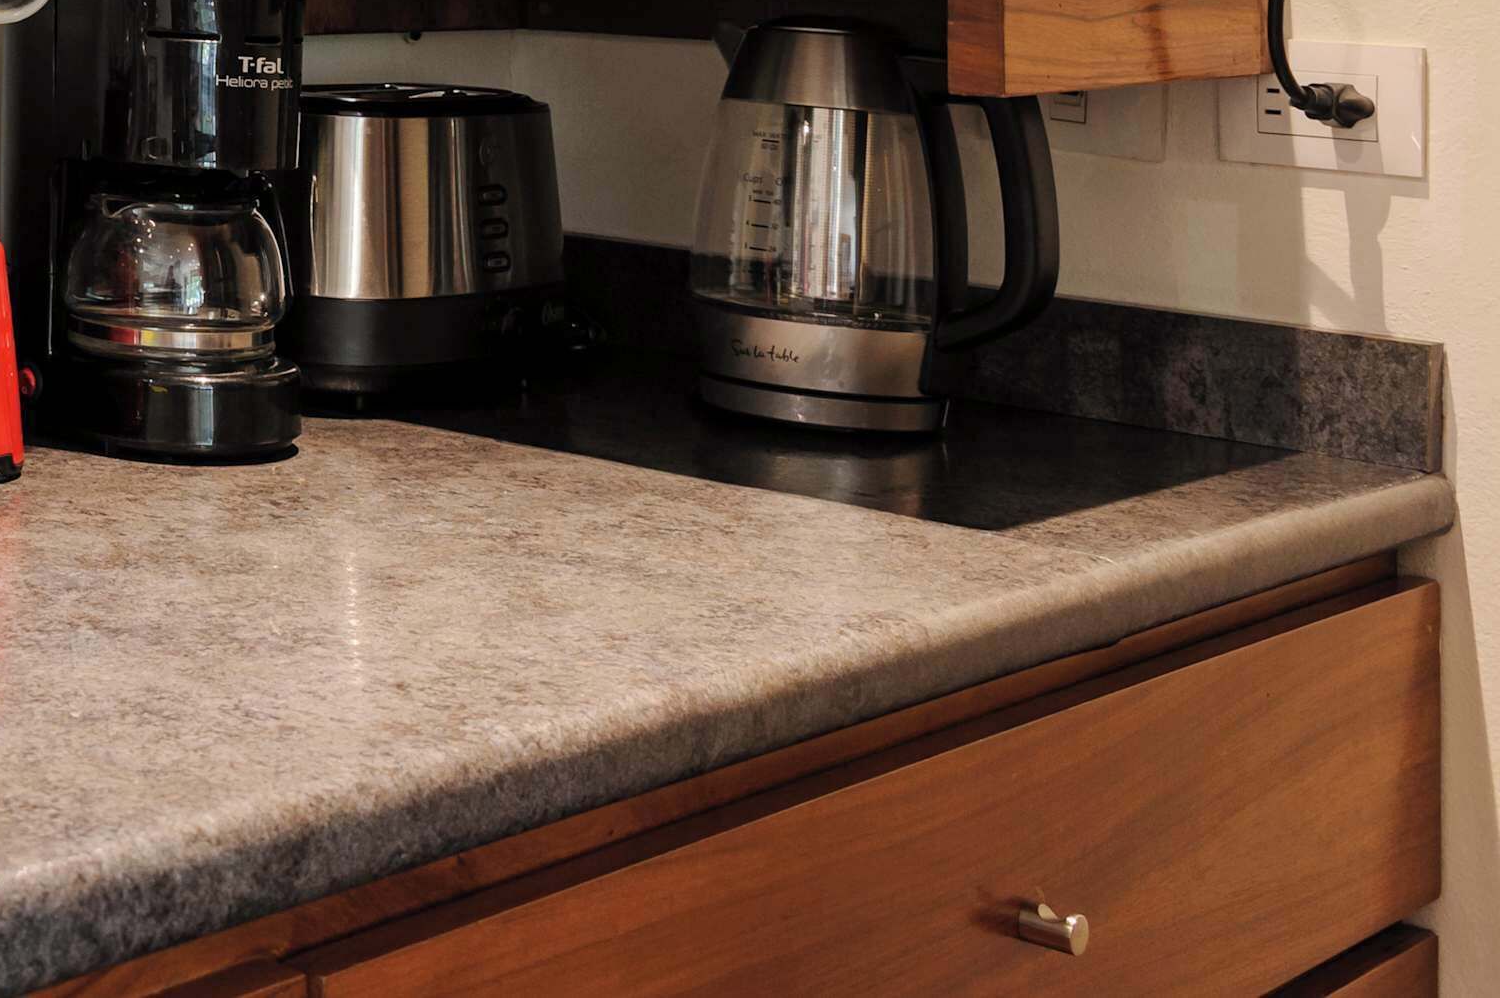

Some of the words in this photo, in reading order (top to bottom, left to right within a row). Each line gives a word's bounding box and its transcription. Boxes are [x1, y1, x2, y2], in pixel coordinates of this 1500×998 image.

[238, 56, 284, 75] T-fal
[216, 74, 269, 89] Heliora
[766, 345, 800, 363] table
